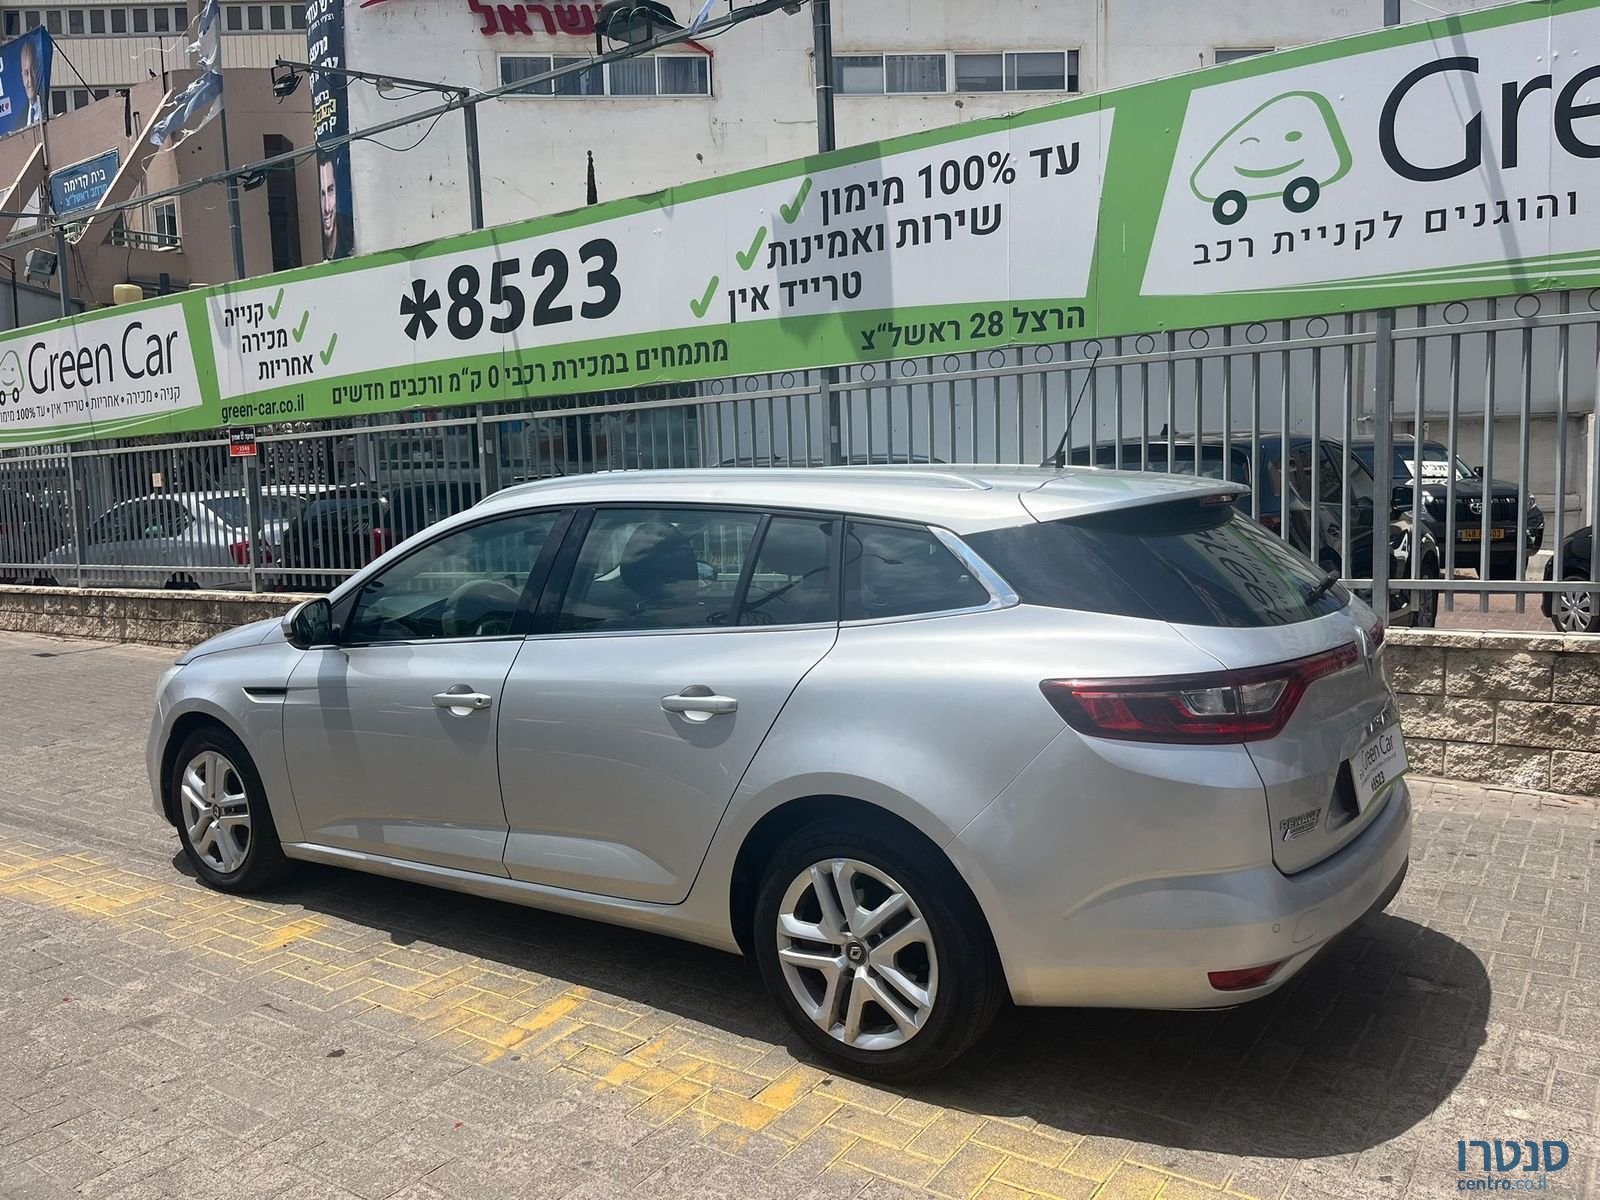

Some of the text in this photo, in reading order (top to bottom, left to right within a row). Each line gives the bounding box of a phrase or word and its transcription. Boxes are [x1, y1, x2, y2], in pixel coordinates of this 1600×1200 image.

[468, 0, 602, 36] שראל
[63, 169, 106, 194] בית קדימה
[820, 141, 1080, 226] עד 100% מימון
[766, 203, 1002, 270] שירות ואמינות
[1192, 190, 1578, 265] והוגנים לקניית רכב
[727, 270, 862, 324] טרייד אין
[224, 302, 264, 328] קנייה
[970, 310, 1004, 339] 28
[1013, 304, 1085, 333] הרצל
[242, 328, 288, 354] מכירה
[28, 321, 178, 395] Green Car
[258, 353, 313, 381] אחריות
[552, 352, 630, 382] במכירת
[636, 338, 729, 371] מתמחים
[390, 373, 443, 400] ורכבים
[488, 365, 500, 388] 0
[504, 362, 546, 388] רכבי
[62, 398, 85, 413] טרייד
[90, 393, 120, 411] אחריות
[126, 389, 154, 405] מכירה
[160, 385, 181, 404] קניה
[332, 381, 385, 405] חדשים
[16, 406, 36, 421] 100%
[36, 404, 46, 417] עד
[51, 402, 62, 419] אין
[221, 394, 305, 423] green-car.co.il
[1379, 734, 1394, 755] Car
